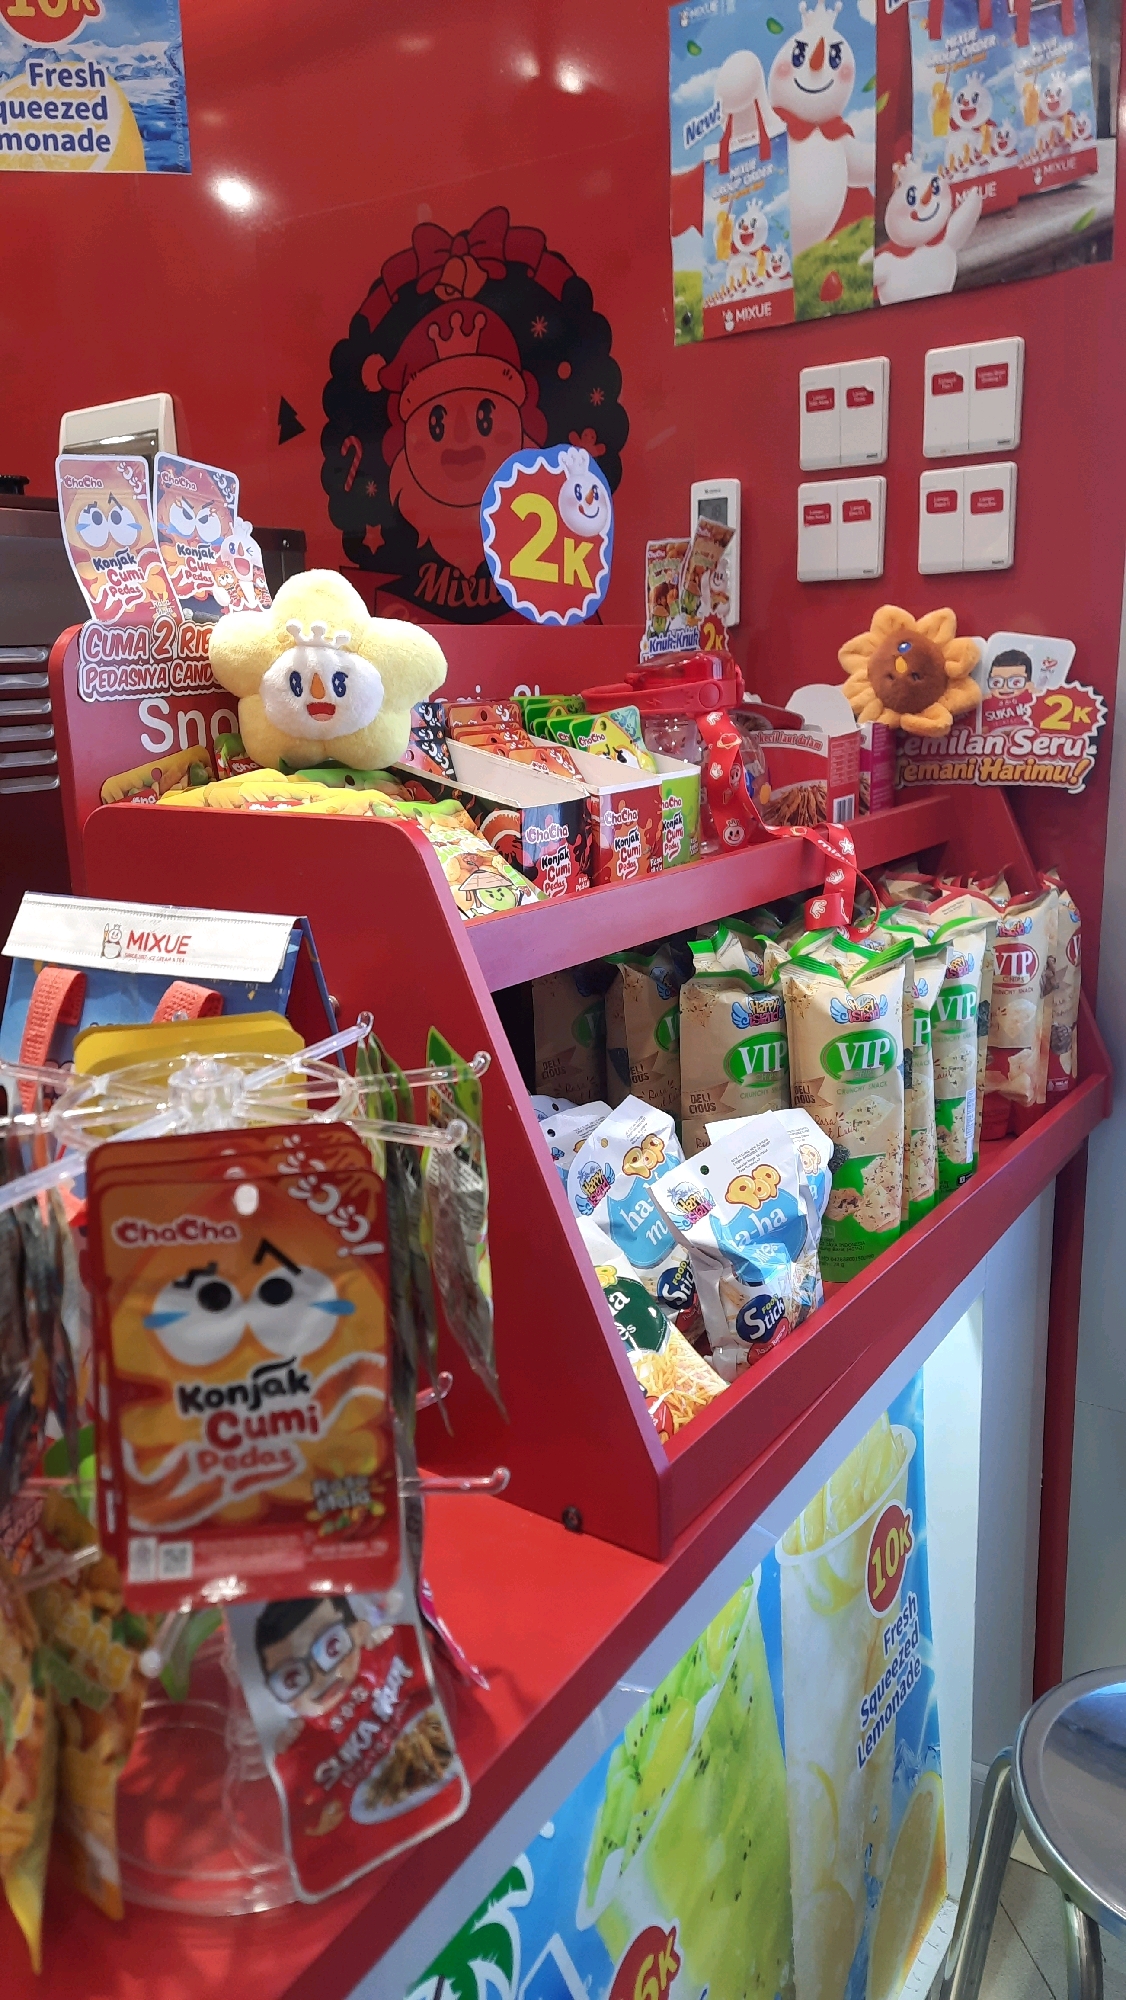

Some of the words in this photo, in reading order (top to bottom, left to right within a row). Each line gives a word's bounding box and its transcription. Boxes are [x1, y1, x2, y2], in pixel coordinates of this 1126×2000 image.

[29, 61, 107, 88] Fresh
[955, 181, 998, 209] MUE
[735, 301, 773, 323] MIXUE
[64, 474, 104, 489] ChaCha
[161, 471, 199, 492] ChaCha
[177, 543, 217, 561] Konjak
[509, 491, 595, 590] 2K
[92, 547, 137, 572] Konjak
[106, 567, 146, 587] Cumi
[109, 585, 142, 597] Pedas
[84, 626, 148, 661] CUMA
[153, 618, 176, 657] 2
[84, 665, 168, 692] PEDASNYA
[171, 662, 215, 686] CAND
[985, 707, 1015, 722] SUKA
[1038, 693, 1094, 731] 2K
[578, 733, 606, 747] ChaCha
[797, 732, 823, 750] dalam
[1010, 727, 1083, 756] Seru
[979, 757, 1092, 783] Harimu!
[604, 807, 639, 826] ChaCha
[525, 822, 570, 844] ChaCha
[614, 827, 641, 851] Konjak
[666, 825, 684, 843] Cumi
[541, 845, 570, 869] Konjak
[620, 844, 643, 863] Cumi
[547, 861, 572, 882] Cumi
[544, 879, 566, 894] Pedas
[126, 930, 193, 955] MIXUE
[994, 951, 1034, 977] VIP
[936, 991, 977, 1023] VIP
[738, 1040, 789, 1075] VIP
[836, 1037, 891, 1071] VIP
[690, 1092, 711, 1105] DELI
[739, 1089, 770, 1100] CRUNCHY
[836, 1084, 866, 1096] CRUNCHY
[867, 1080, 888, 1091] SNACK
[688, 1101, 717, 1115] CIOUS
[113, 1218, 241, 1246] ChaCha
[671, 1260, 688, 1286] FOOD
[743, 1296, 787, 1340] Stick
[175, 1357, 311, 1417] Konjak
[206, 1404, 319, 1449] Cumi
[198, 1446, 294, 1473] Pedas
[872, 1517, 911, 1599] 10K
[883, 1596, 917, 1656] Fresh
[861, 1630, 919, 1728] Squeezed
[857, 1664, 922, 1770] Lemonade
